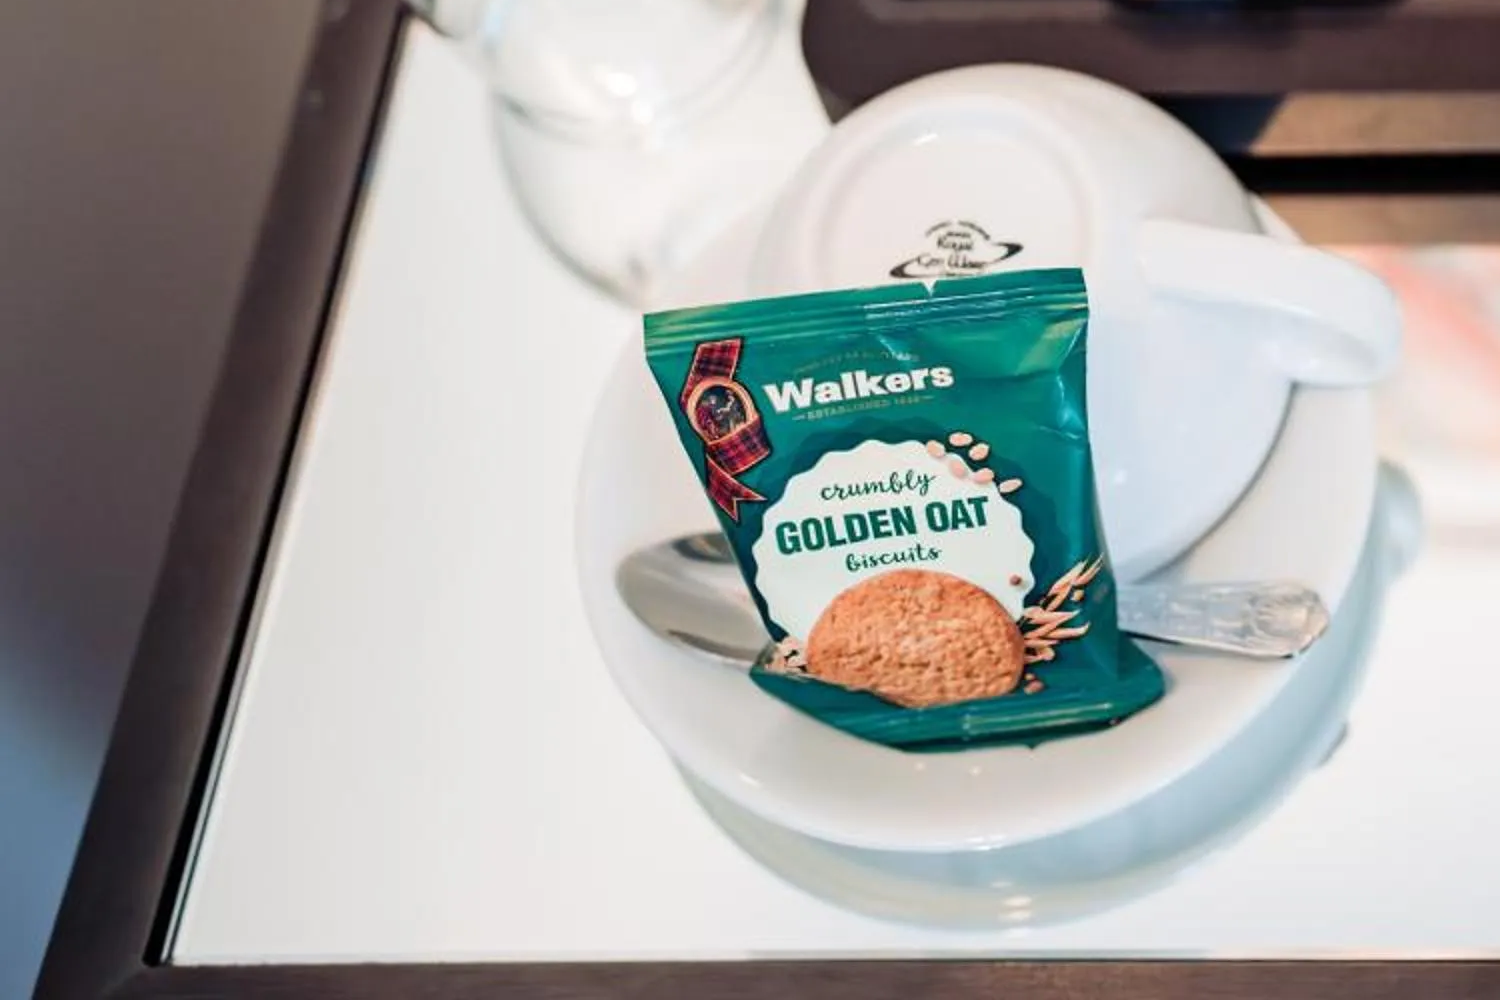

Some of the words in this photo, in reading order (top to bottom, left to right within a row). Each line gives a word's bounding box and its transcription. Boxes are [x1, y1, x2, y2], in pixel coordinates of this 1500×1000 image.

[762, 365, 955, 414] Walkers
[820, 468, 936, 502] crumbly
[775, 504, 918, 555] GOLDEN
[925, 495, 989, 533] OAT
[845, 543, 942, 572] biscuits
